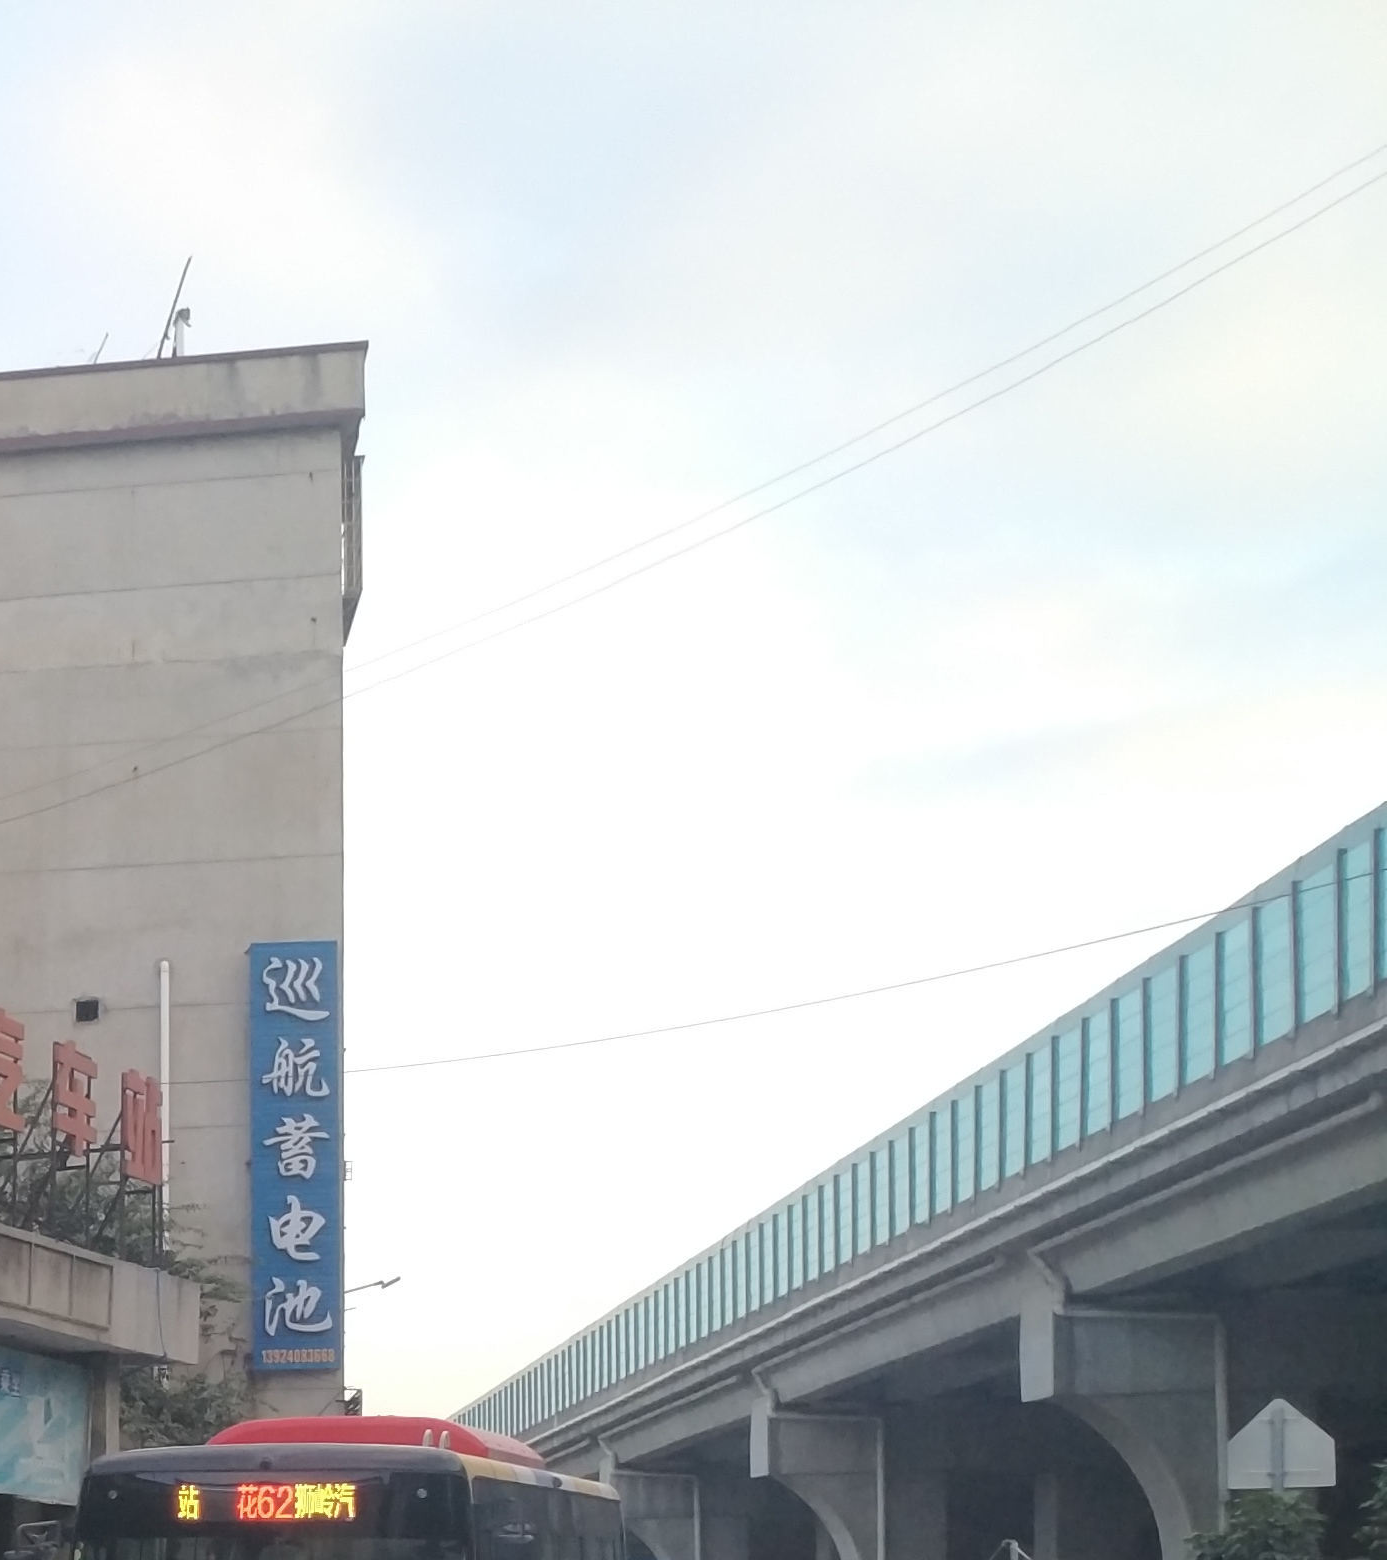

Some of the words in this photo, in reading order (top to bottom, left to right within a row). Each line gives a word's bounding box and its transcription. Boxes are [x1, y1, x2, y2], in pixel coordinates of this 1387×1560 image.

[261, 955, 334, 1338] 巡航蓄电池
[177, 1483, 200, 1520] 站
